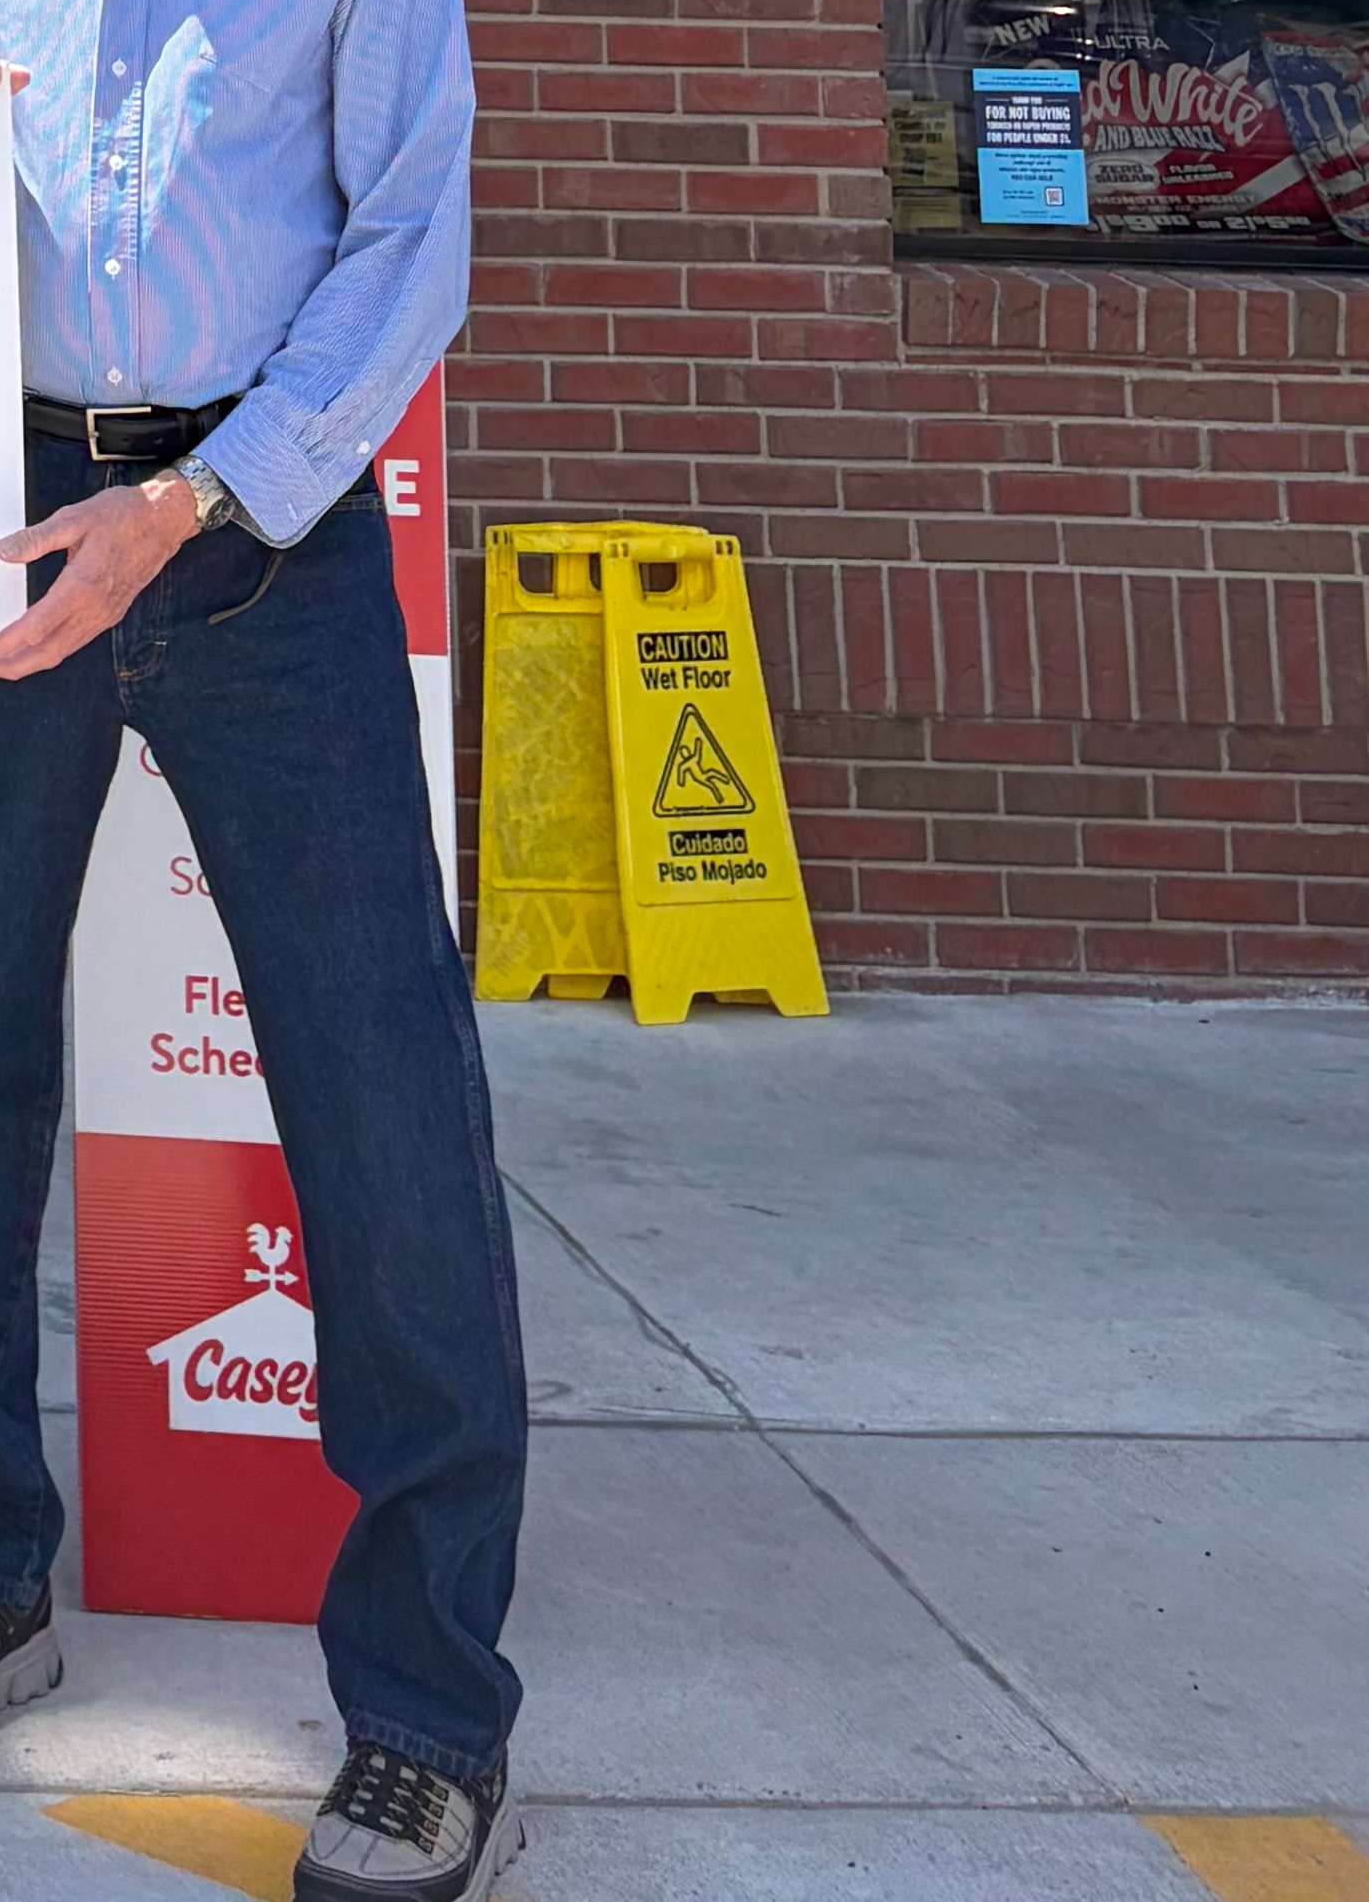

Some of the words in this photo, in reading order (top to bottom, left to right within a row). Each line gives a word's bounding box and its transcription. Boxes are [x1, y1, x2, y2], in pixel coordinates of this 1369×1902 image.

[993, 15, 1051, 46] NEW
[1094, 35, 1170, 51] ULTRA
[985, 105, 1006, 120] FOR
[1009, 106, 1030, 120] NOT
[1032, 107, 1071, 121] BUYING
[1095, 125, 1129, 152] AND
[1134, 125, 1177, 148] BLUE
[1175, 125, 1227, 154] RAZZ
[640, 633, 726, 661] CAUTION
[640, 667, 678, 691] Wet
[681, 666, 731, 689] Floor
[671, 832, 747, 856] Cuidado
[657, 861, 697, 883] Piso
[701, 859, 768, 885] Mojado
